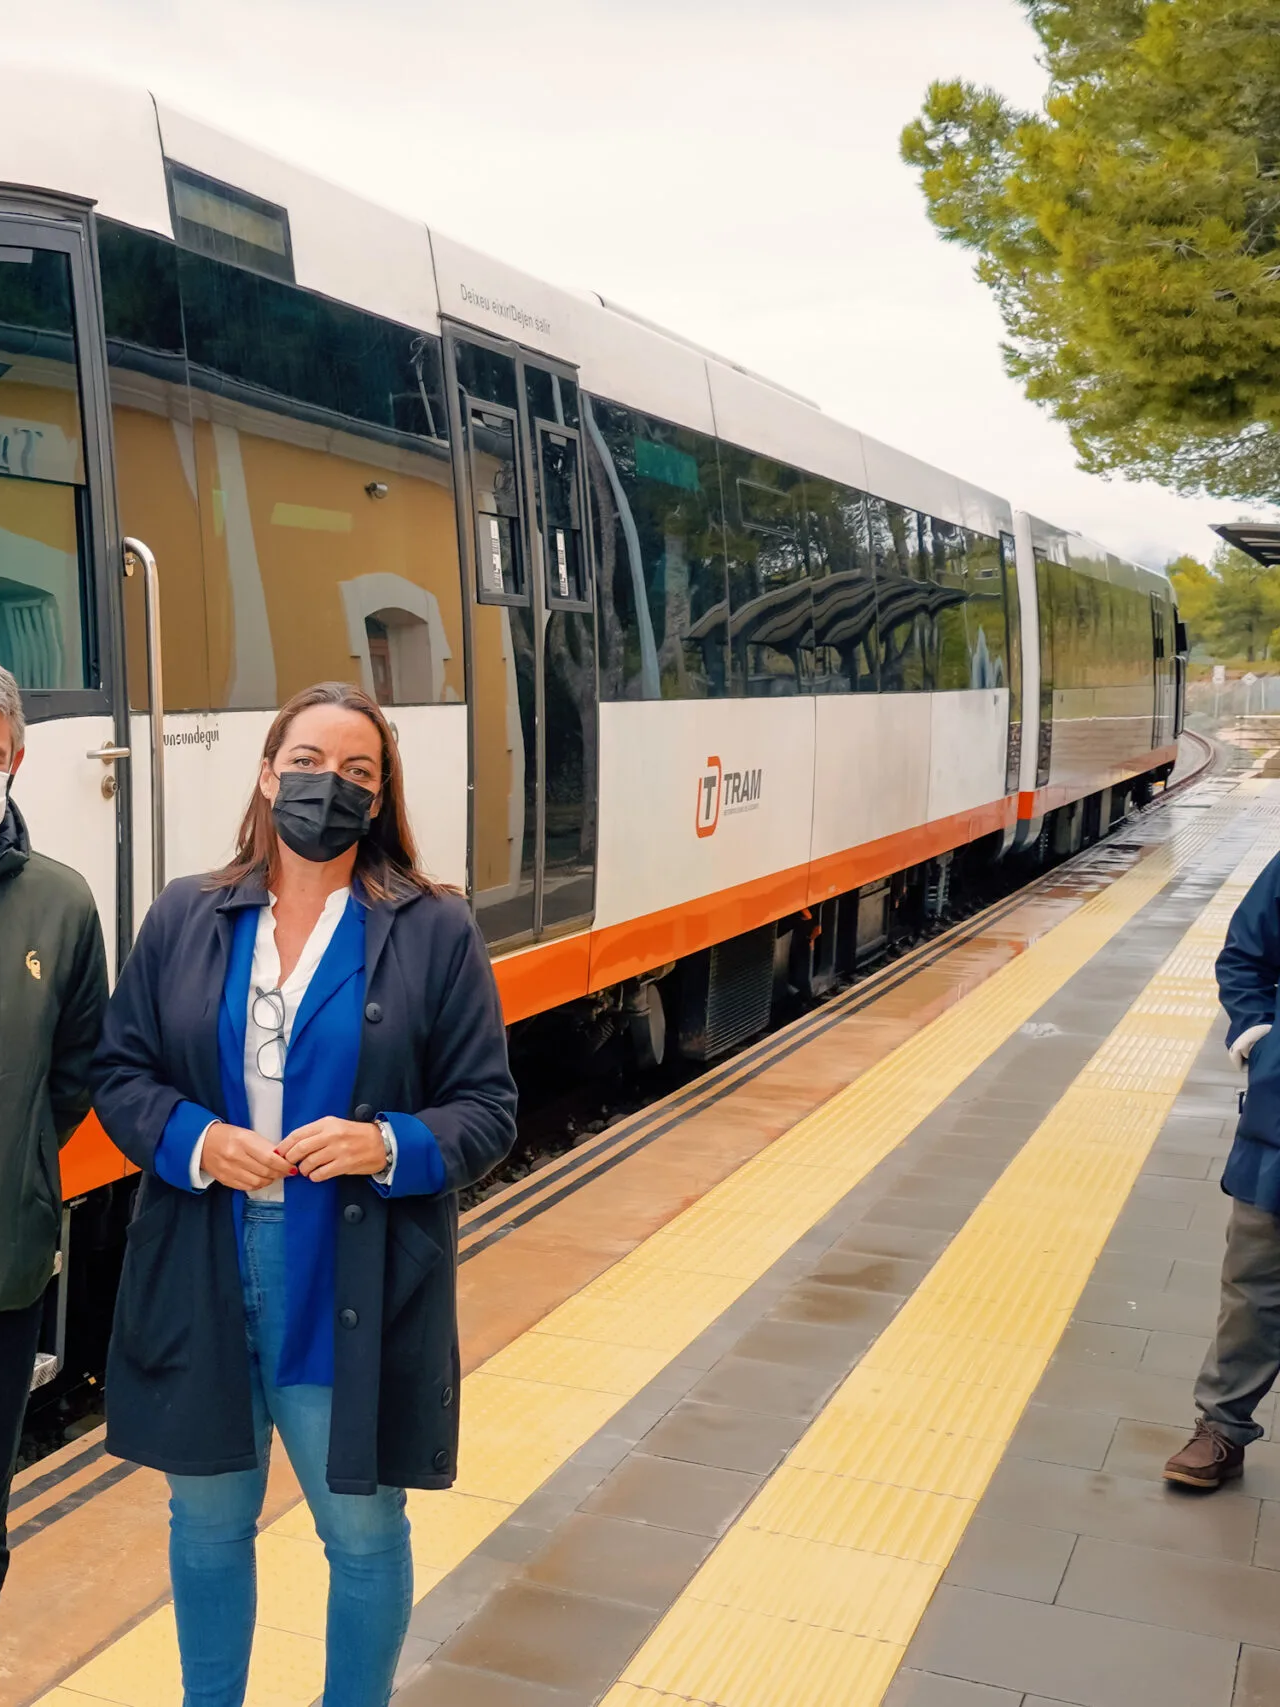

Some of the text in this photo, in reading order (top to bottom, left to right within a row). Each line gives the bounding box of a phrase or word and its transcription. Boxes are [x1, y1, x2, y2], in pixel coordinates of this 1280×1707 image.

[460, 283, 490, 311] Deixeu
[534, 313, 551, 336] salir
[723, 768, 762, 805] TRAM
